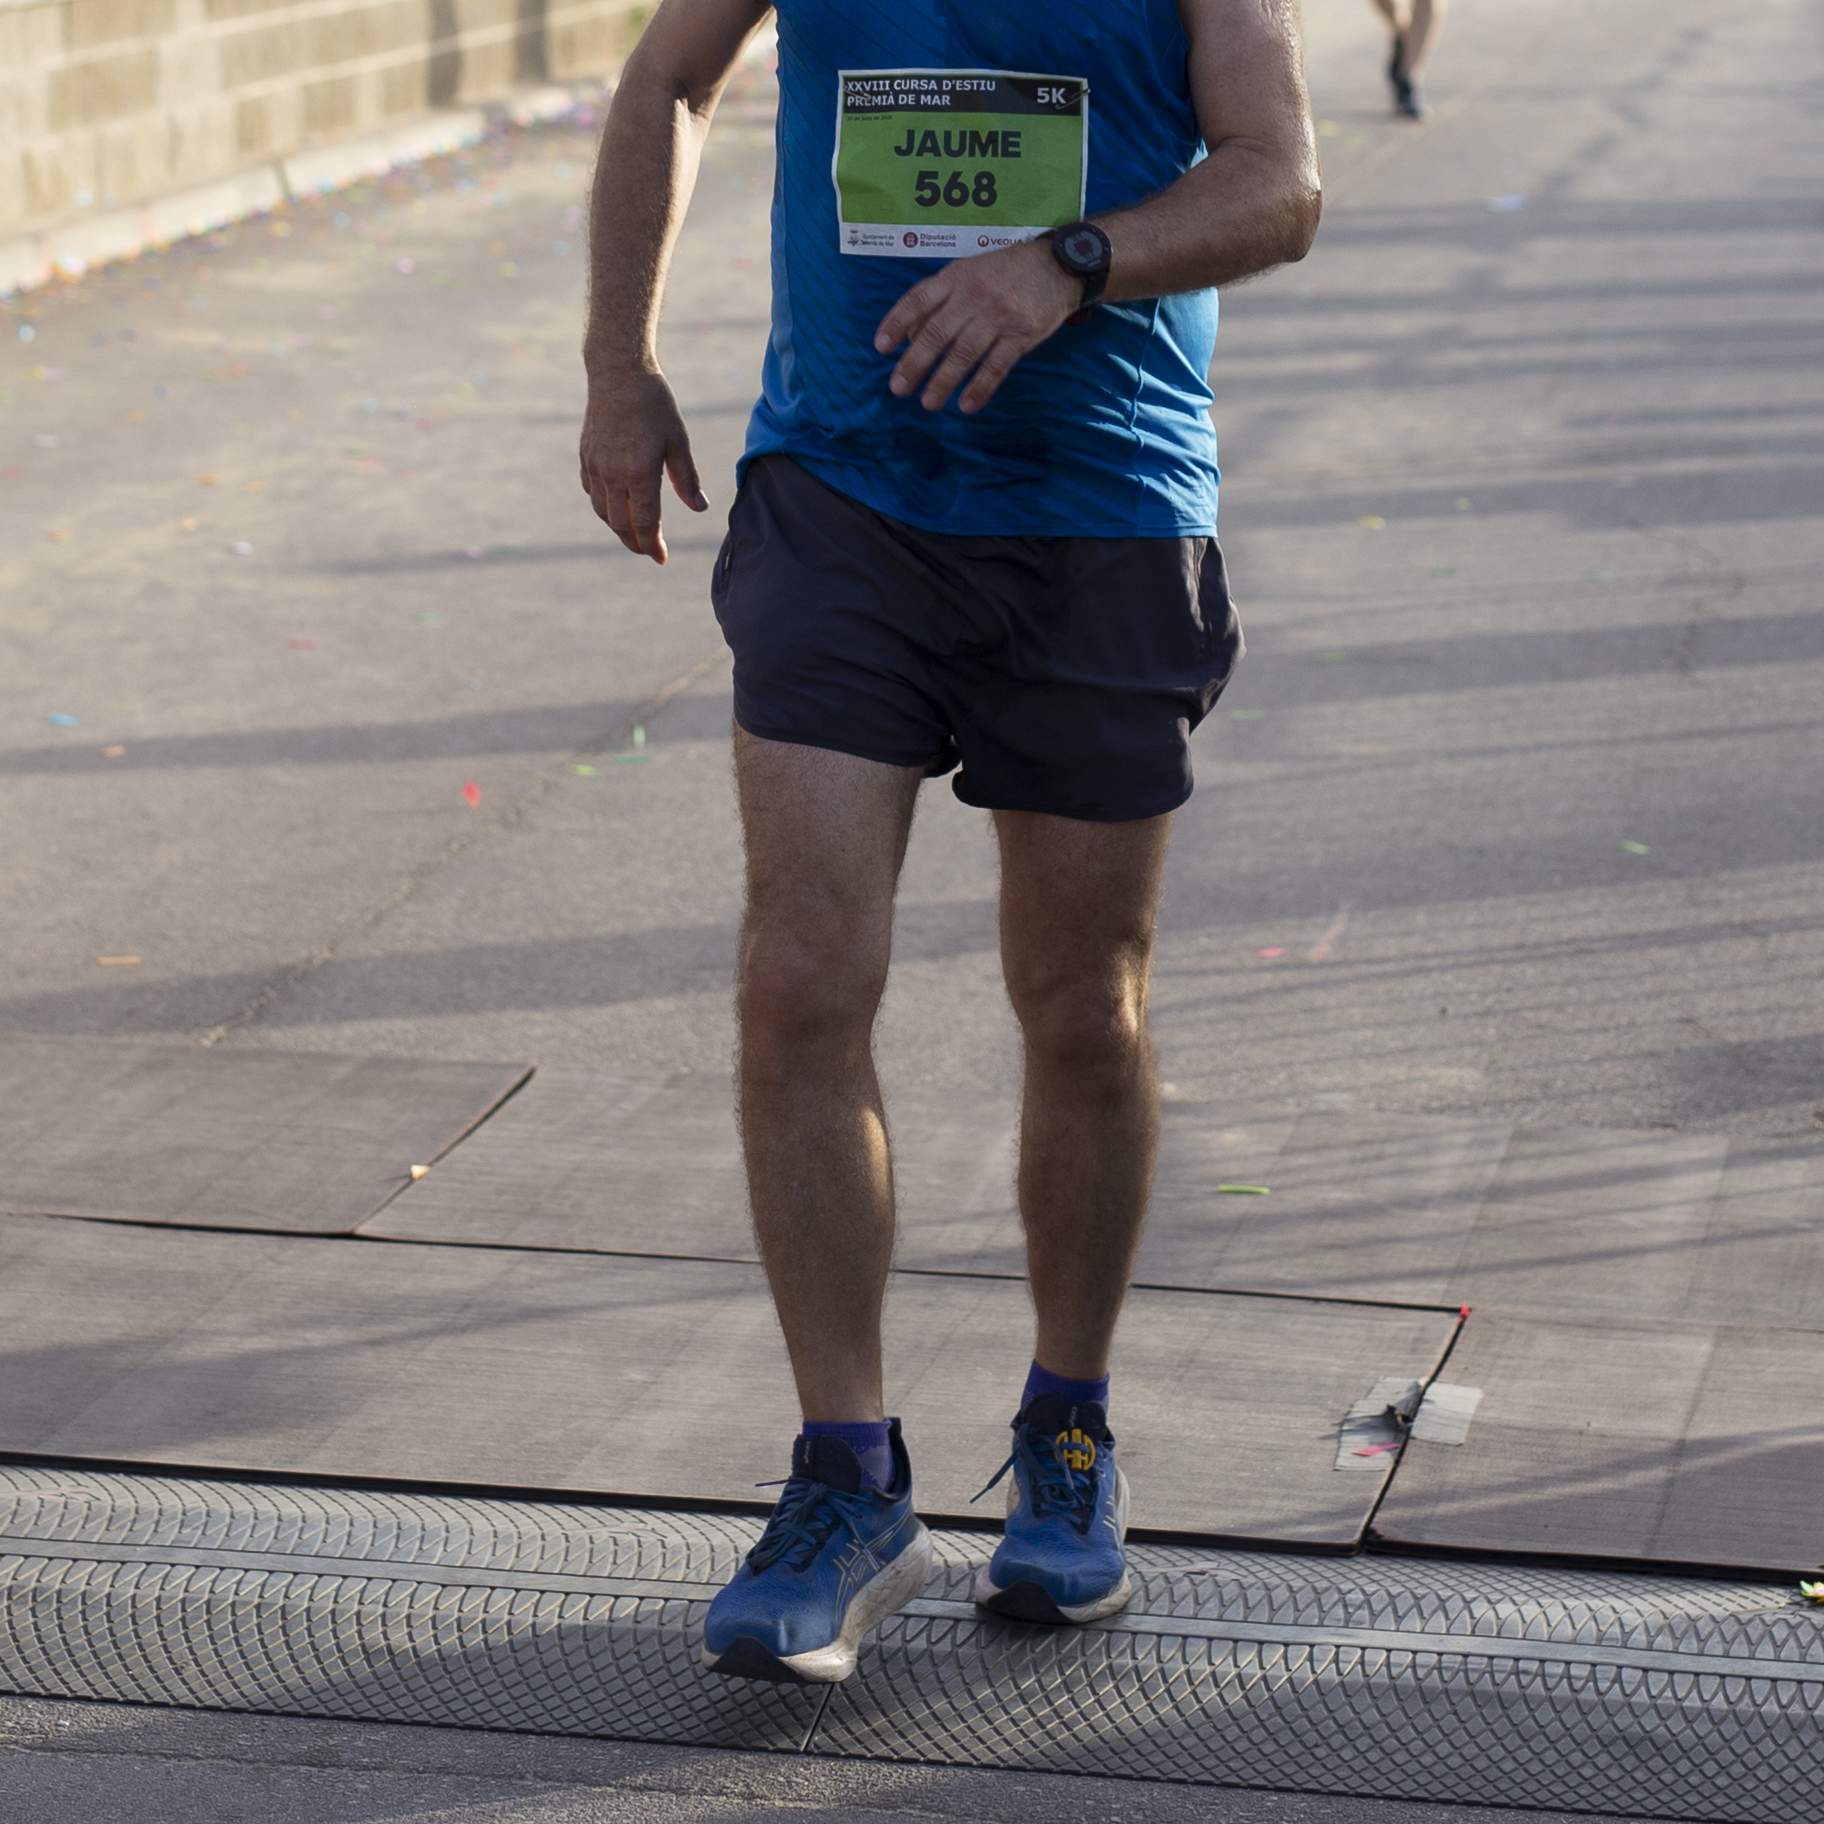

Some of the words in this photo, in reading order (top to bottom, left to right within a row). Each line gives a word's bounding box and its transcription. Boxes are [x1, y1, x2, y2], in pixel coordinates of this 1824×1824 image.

[847, 80, 890, 91] XXVIII
[894, 80, 938, 90] CURSA
[942, 80, 996, 91] D'ESTIU
[847, 91, 895, 106] PREMIÀ
[898, 94, 916, 105] DE
[920, 95, 951, 105] MAR
[1037, 87, 1066, 104] 5K
[894, 129, 1022, 158] JAUME
[914, 170, 998, 207] 568
[920, 233, 957, 241] Diputació
